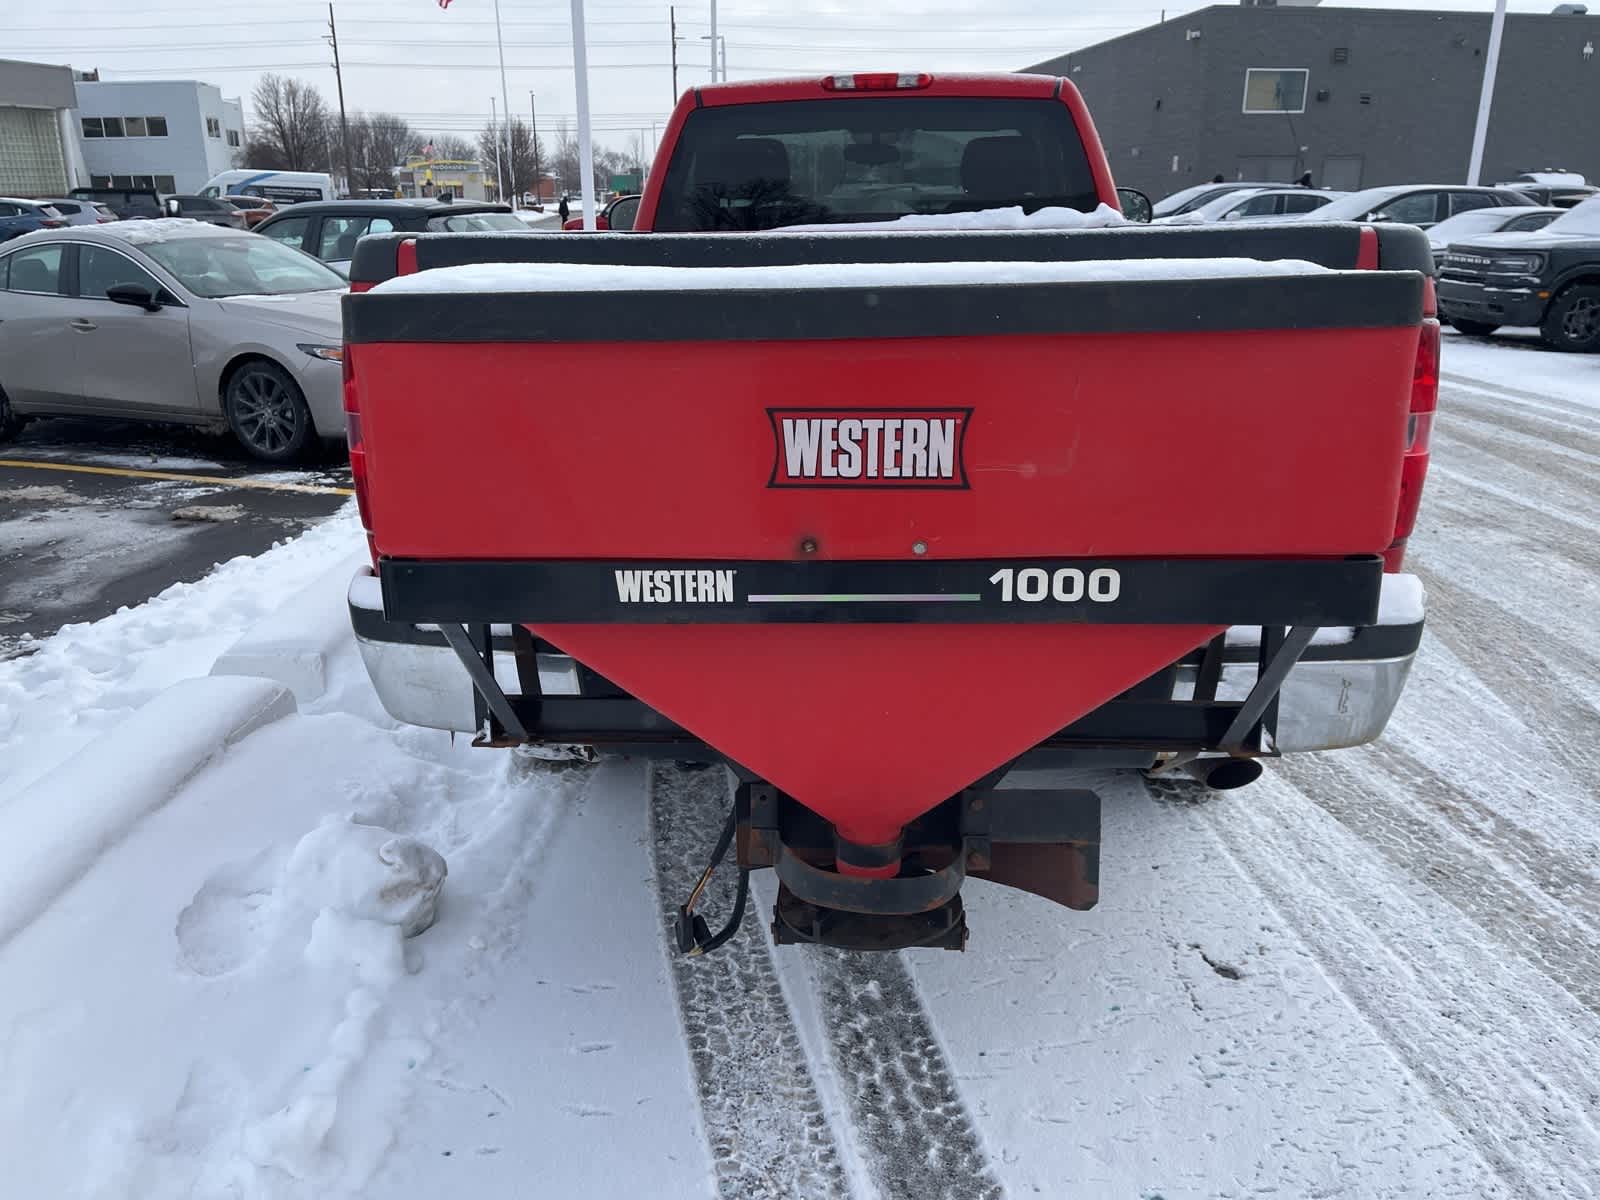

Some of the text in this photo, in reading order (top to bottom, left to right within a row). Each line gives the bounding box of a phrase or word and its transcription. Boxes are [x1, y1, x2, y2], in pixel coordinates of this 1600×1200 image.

[782, 419, 955, 477] WESTERN
[615, 568, 1121, 603] WESTERN 1000
